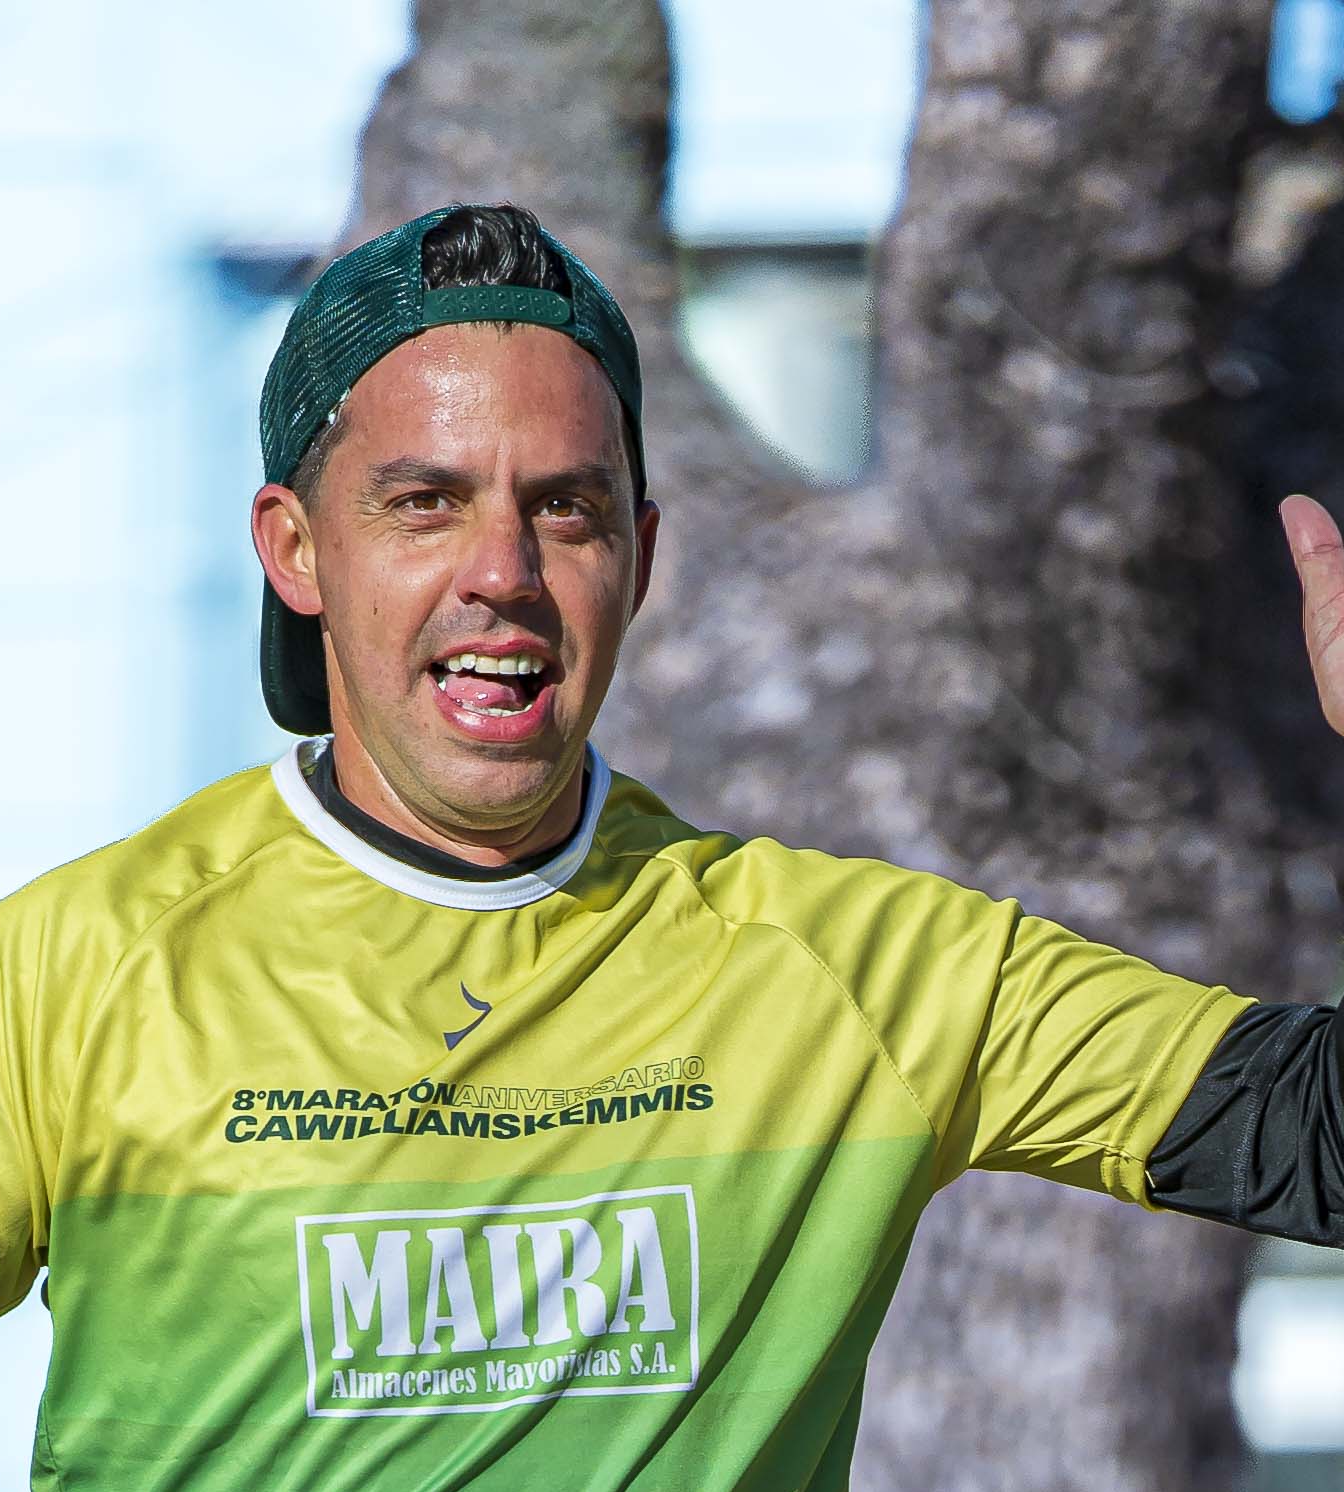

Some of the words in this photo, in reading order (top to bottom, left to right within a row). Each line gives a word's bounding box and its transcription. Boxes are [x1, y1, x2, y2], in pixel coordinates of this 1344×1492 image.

[224, 1083, 715, 1144] CAWILLIAMSKEMMIS
[321, 1207, 677, 1360] MAIRA
[331, 1364, 476, 1401] Almacenes
[486, 1347, 622, 1394] Mayoristas
[629, 1341, 677, 1377] S.A.
